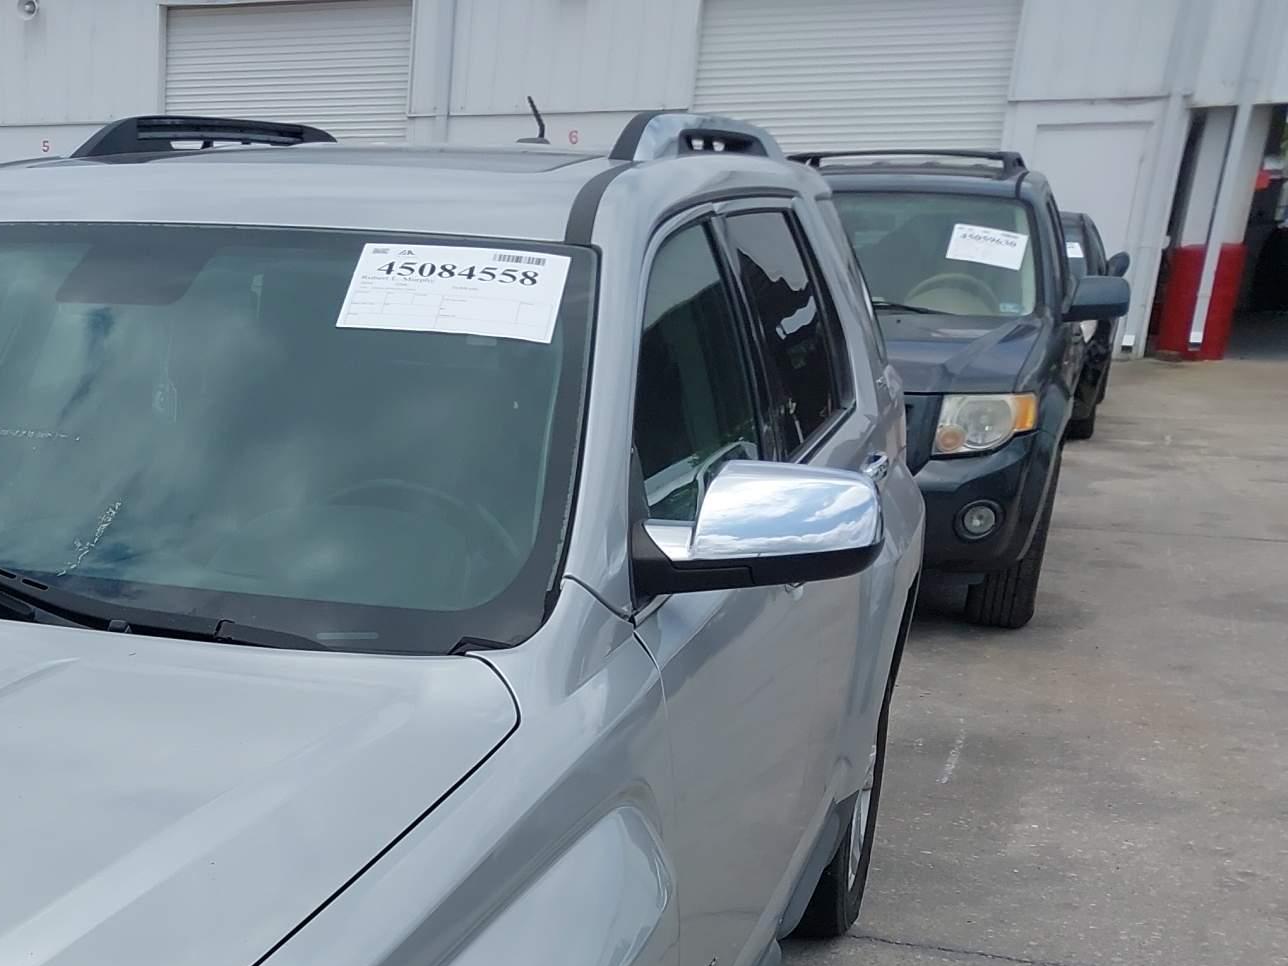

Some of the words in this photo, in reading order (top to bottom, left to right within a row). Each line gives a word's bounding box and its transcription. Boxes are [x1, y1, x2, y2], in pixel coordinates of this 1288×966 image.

[569, 130, 578, 144] 6
[42, 140, 50, 152] 5
[376, 260, 539, 286] 45084558
